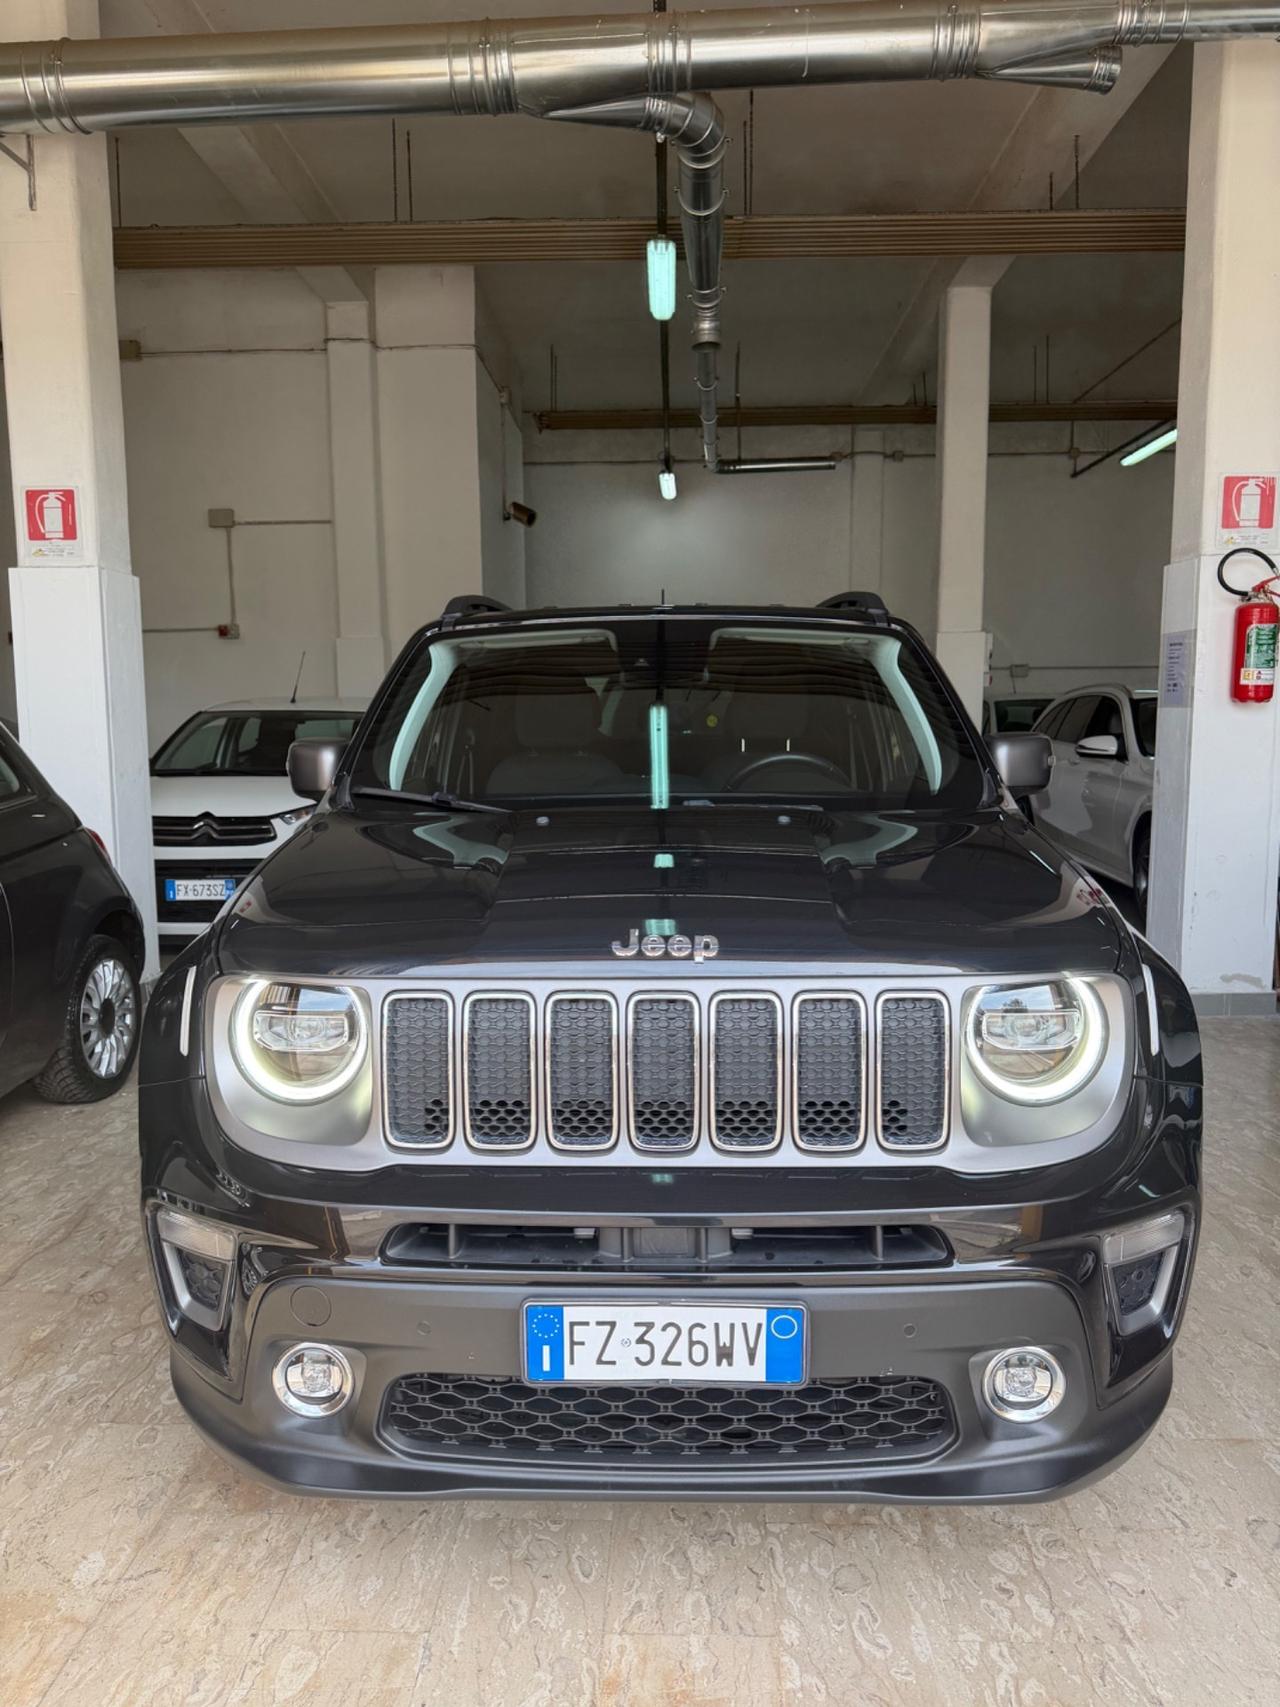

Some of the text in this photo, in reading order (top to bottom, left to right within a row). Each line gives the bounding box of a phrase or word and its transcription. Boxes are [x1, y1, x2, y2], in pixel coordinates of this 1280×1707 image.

[176, 884, 225, 897] FX 673SZ
[611, 928, 720, 964] Jeep
[542, 1345, 551, 1372] I
[568, 1321, 763, 1367] FZ 326WV
